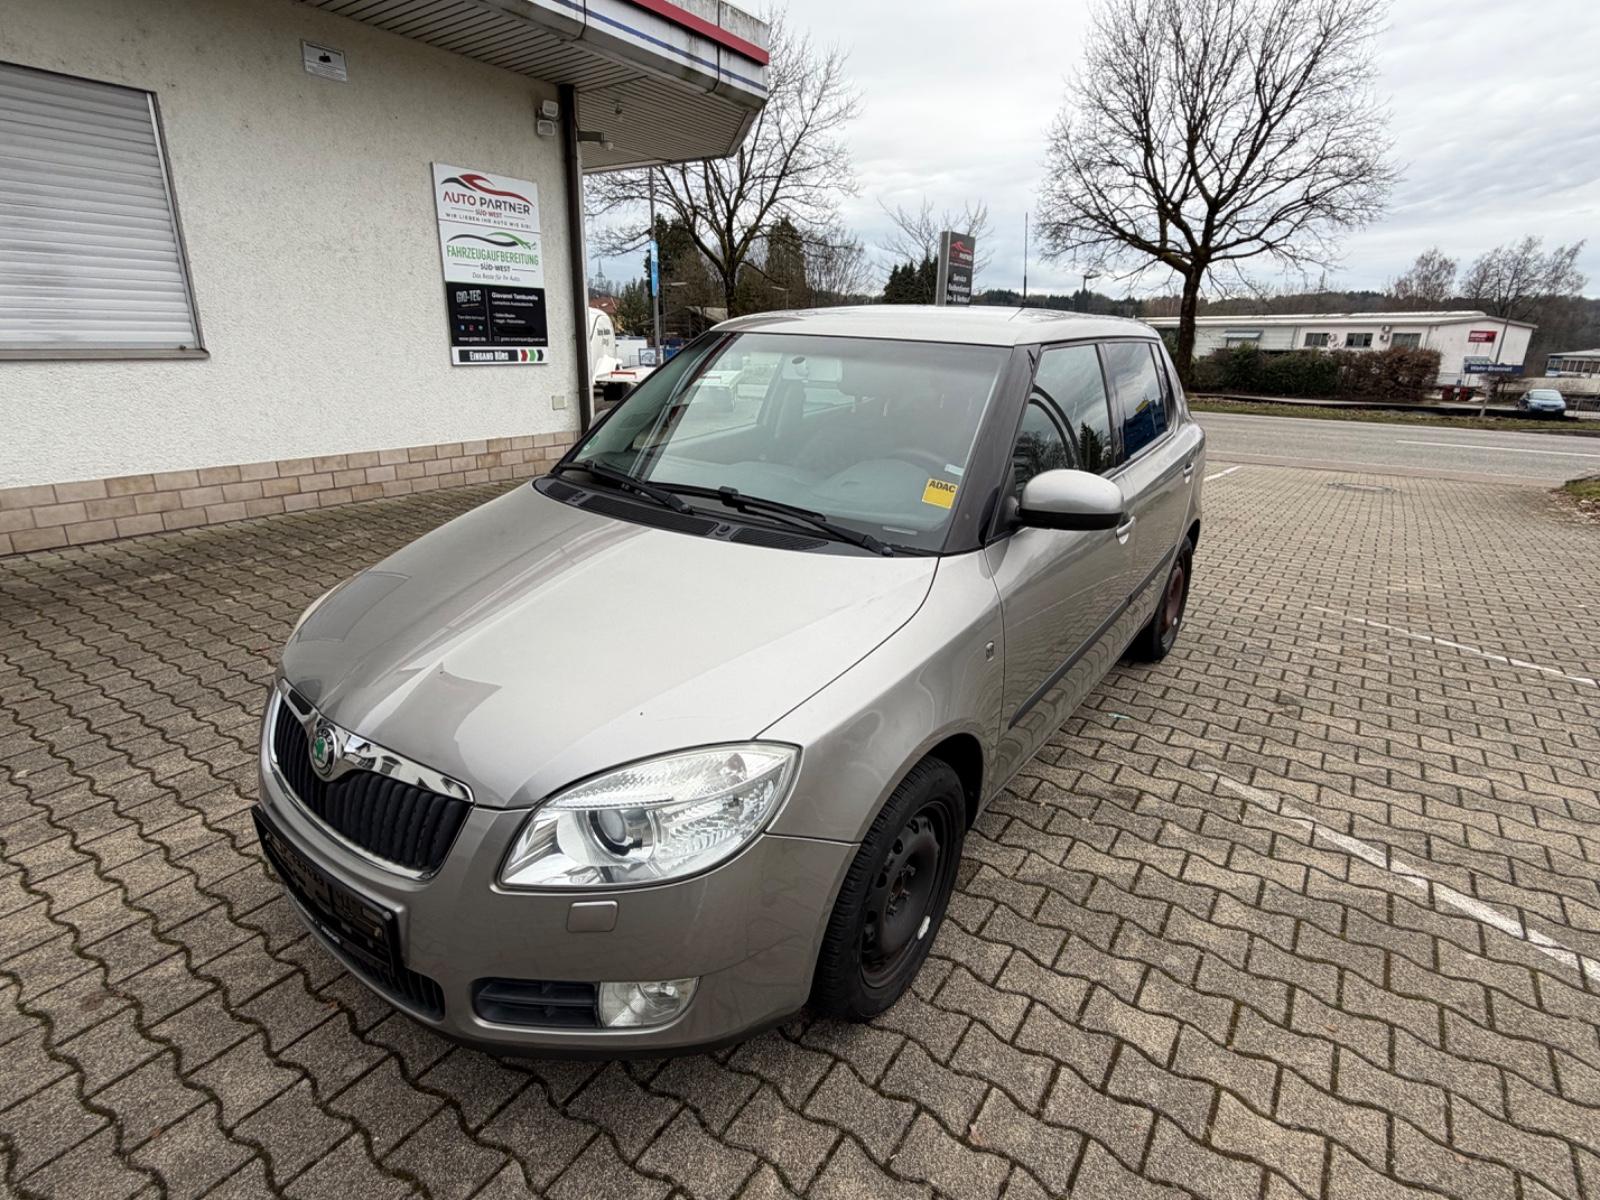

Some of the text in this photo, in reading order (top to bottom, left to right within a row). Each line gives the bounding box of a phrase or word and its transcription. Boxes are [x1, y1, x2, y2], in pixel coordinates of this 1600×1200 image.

[443, 191, 530, 215] AUTO PARTNER
[446, 245, 539, 266] FAHRZEUGAUFBEREITUNG
[469, 351, 494, 361] EINGANG
[929, 480, 956, 493] ADAC
